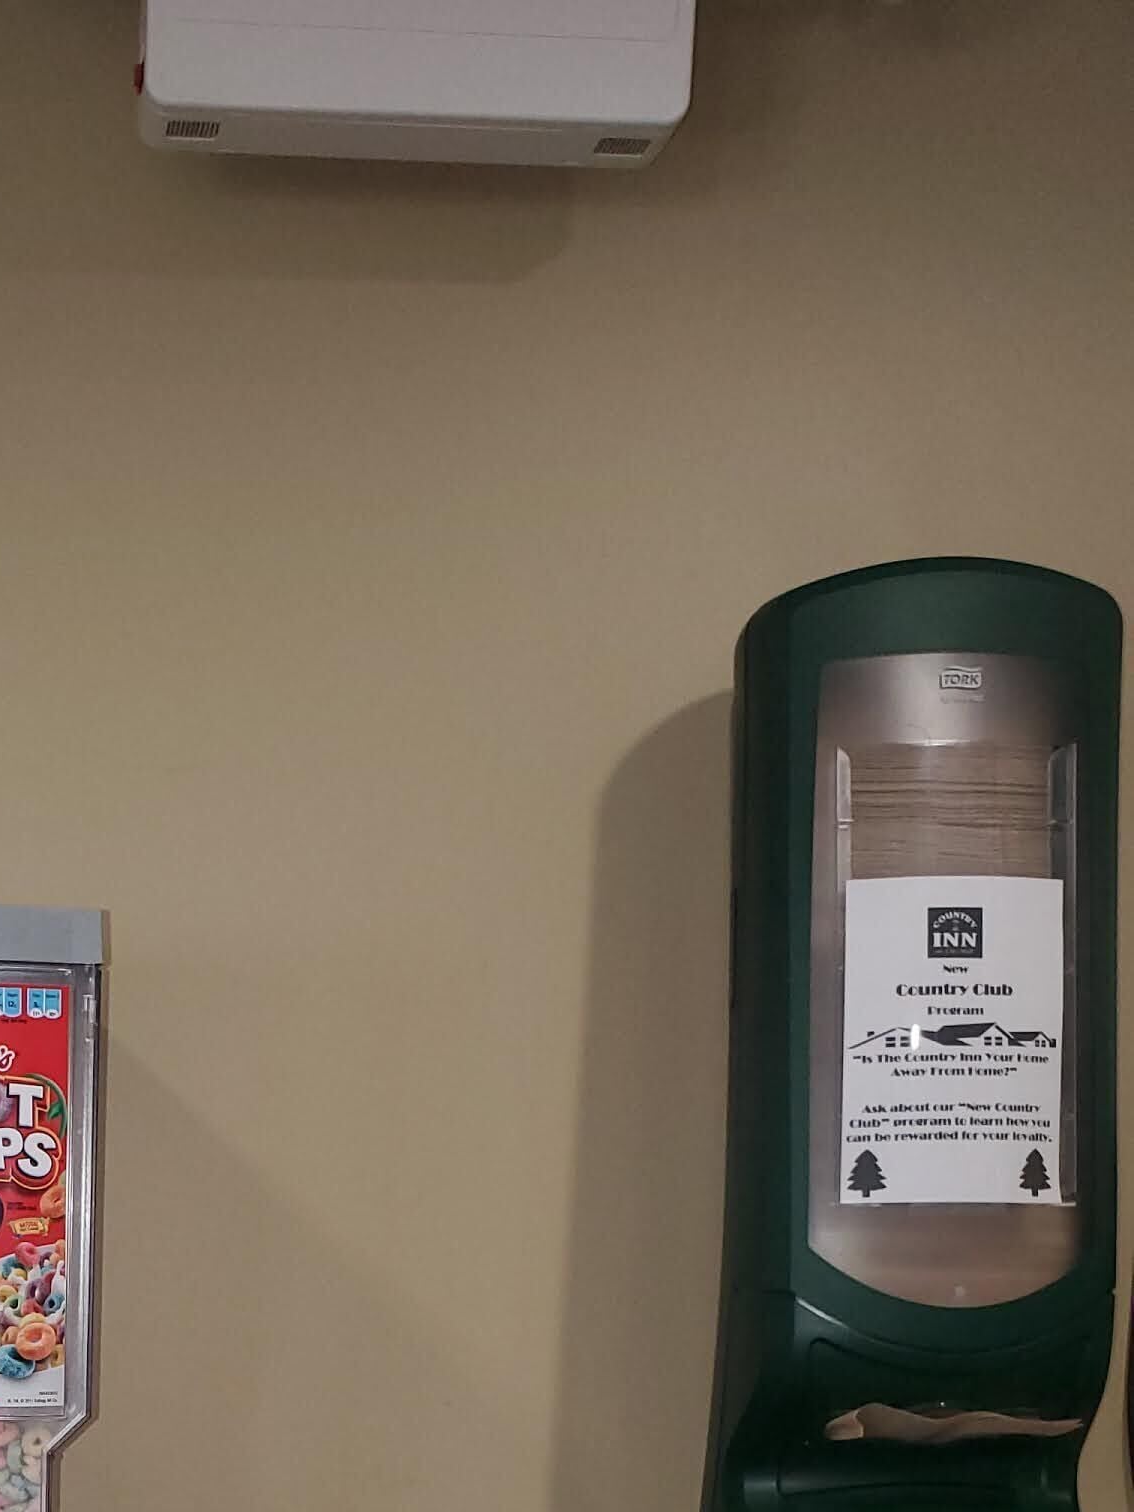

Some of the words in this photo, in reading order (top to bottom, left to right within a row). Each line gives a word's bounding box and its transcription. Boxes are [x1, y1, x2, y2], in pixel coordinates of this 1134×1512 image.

[944, 674, 979, 685] TORK
[932, 911, 978, 929] COUNTRY
[932, 932, 978, 948] INN
[943, 965, 968, 974] New
[896, 983, 969, 996] Country
[972, 983, 1013, 996] Club
[927, 1006, 984, 1016] Program
[877, 1053, 901, 1063] The
[904, 1053, 956, 1064] Country
[960, 1053, 981, 1062] Inn
[985, 1053, 1014, 1063] Your
[1017, 1053, 1049, 1064] Home
[890, 1068, 926, 1077] Away
[930, 1067, 965, 1076] From
[862, 1104, 886, 1113] Ask
[890, 1103, 929, 1113] about
[933, 1104, 953, 1112] our
[995, 1103, 1041, 1113] Country
[893, 1118, 951, 1128] program
[955, 1117, 966, 1126] to
[970, 1117, 1003, 1126] learn
[1006, 1117, 1029, 1127] how
[1031, 1118, 1050, 1128] you
[846, 1134, 871, 1142] can
[875, 1132, 891, 1141] be
[894, 1131, 958, 1141] rewarded
[962, 1130, 977, 1140] for
[982, 1131, 1009, 1142] your
